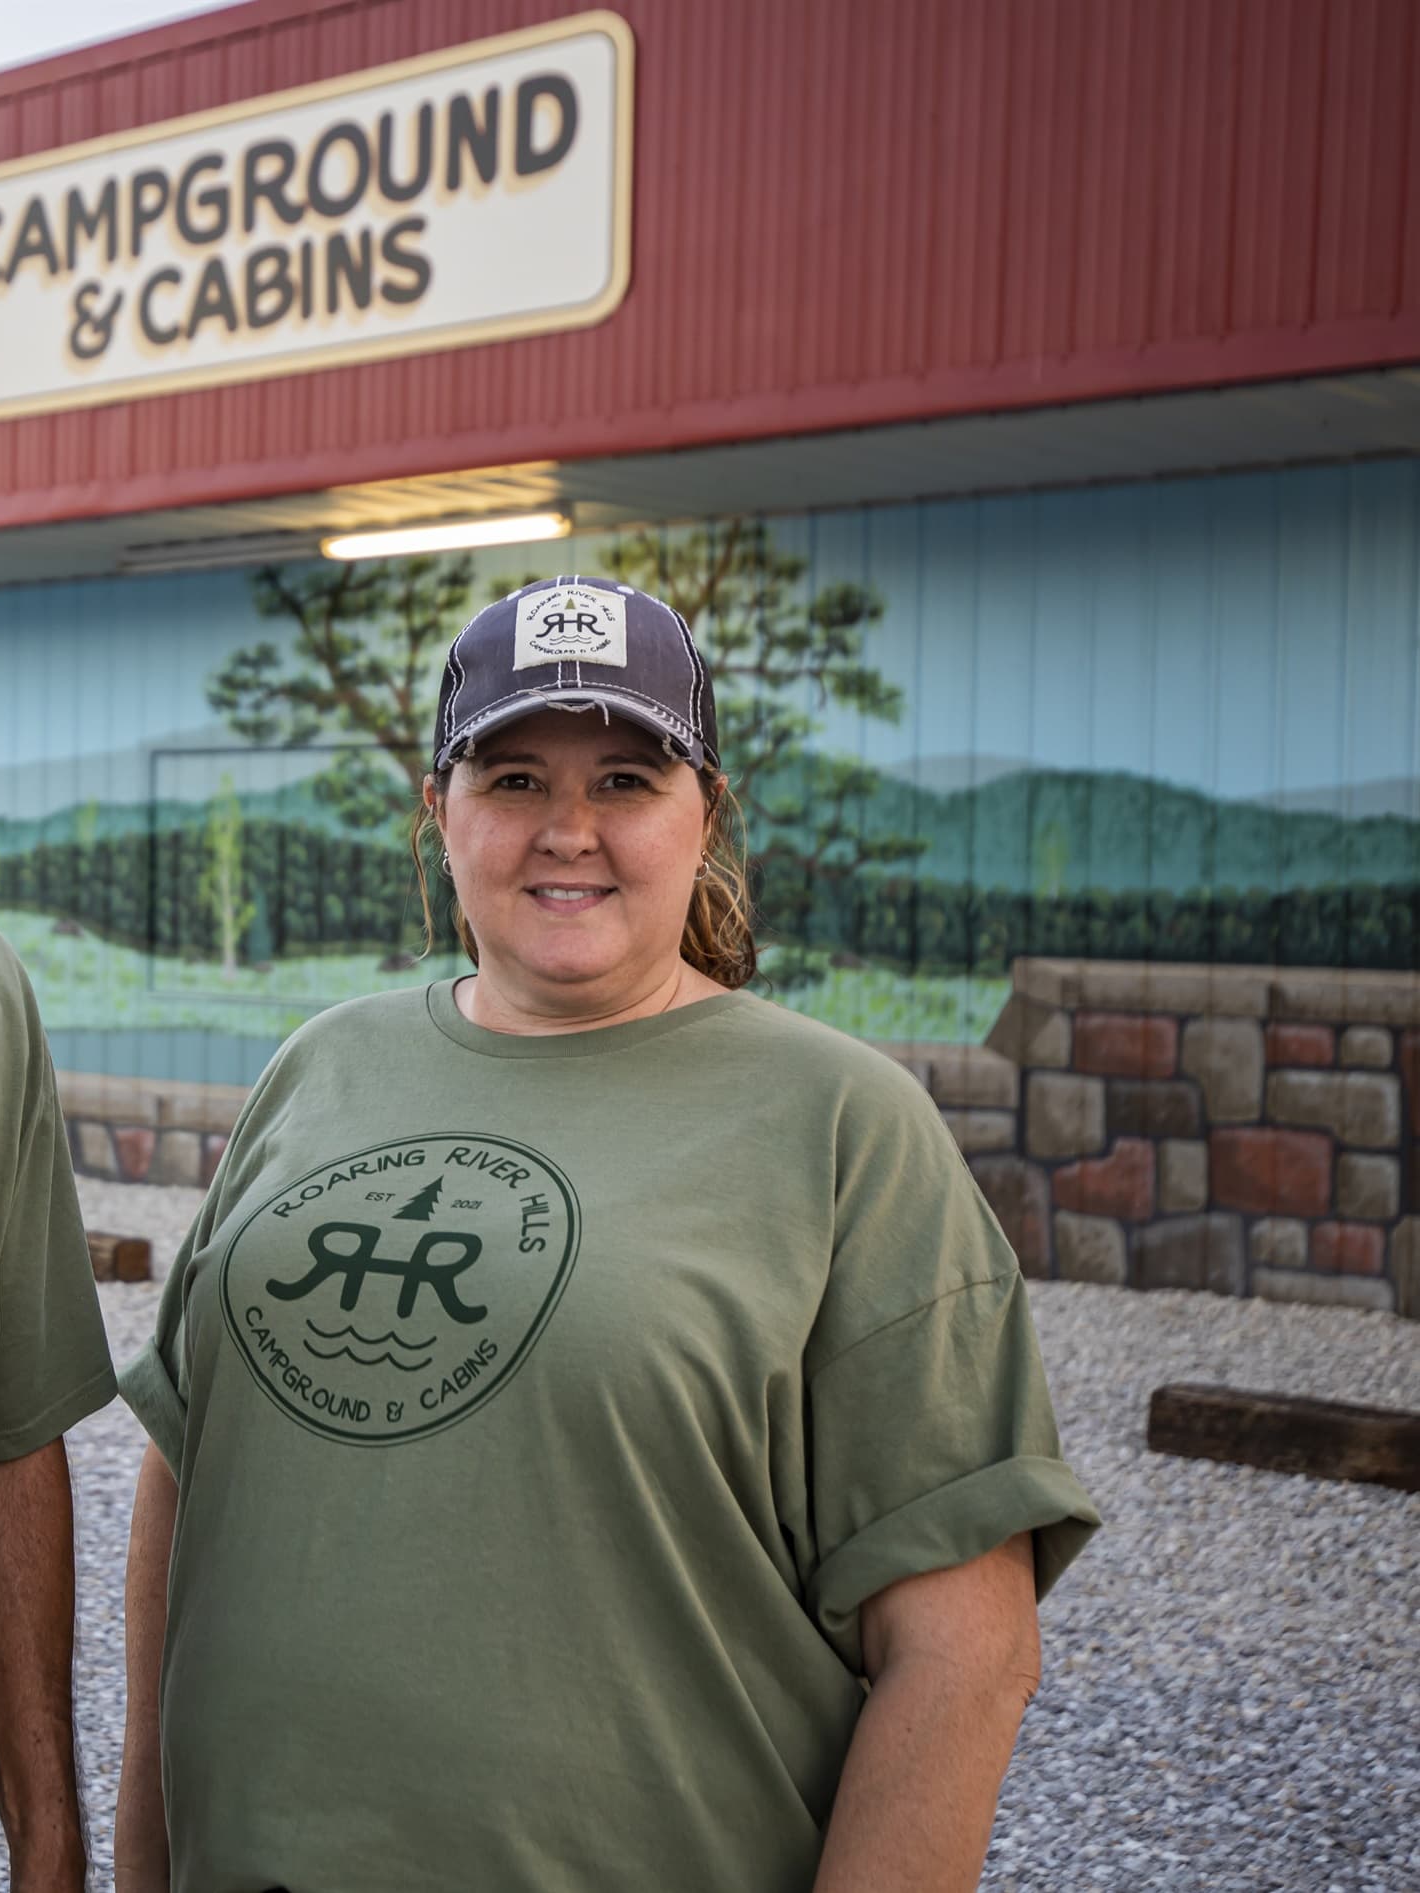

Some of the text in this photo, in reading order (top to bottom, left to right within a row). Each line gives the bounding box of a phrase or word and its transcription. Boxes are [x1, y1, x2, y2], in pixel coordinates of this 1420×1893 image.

[69, 217, 433, 361] & CABINS
[272, 1146, 550, 1254] ROARING RIVER HILLS
[364, 1191, 483, 1210] EST 2021
[244, 1305, 498, 1423] CAMPGROUND & CABINS
